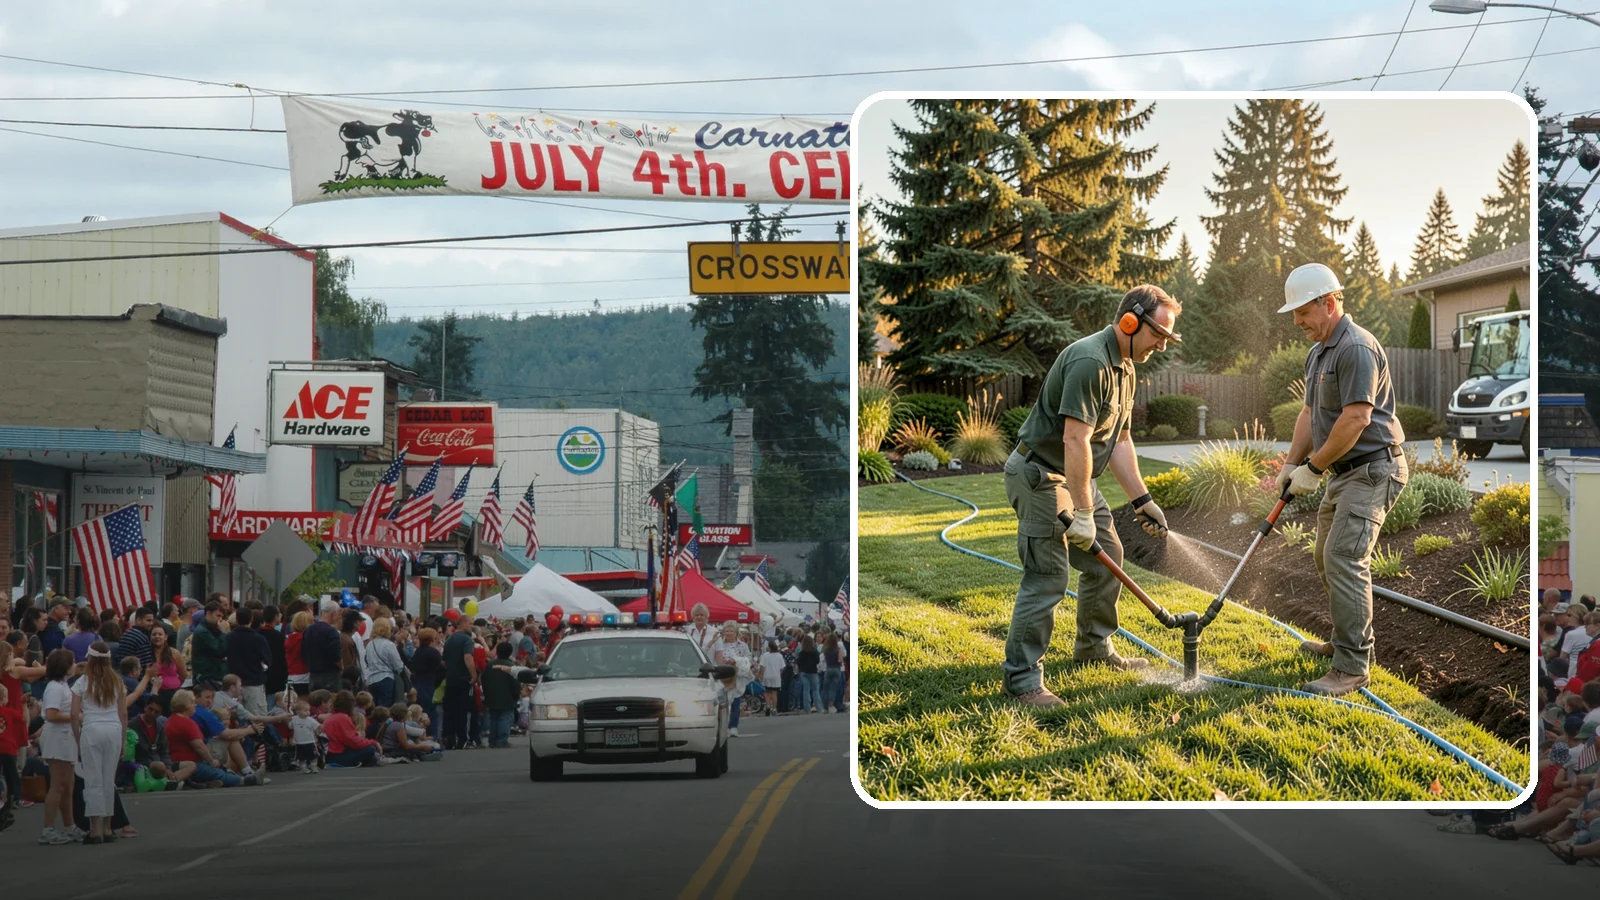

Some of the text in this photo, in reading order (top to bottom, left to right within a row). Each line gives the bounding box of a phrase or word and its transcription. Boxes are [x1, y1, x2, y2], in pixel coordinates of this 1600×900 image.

[695, 121, 850, 150] Carnat
[481, 141, 605, 192] JULY
[632, 150, 747, 198] 4th.
[696, 254, 850, 280] CROSSWA
[283, 380, 373, 420] ACE
[405, 409, 453, 422] CEDAR
[283, 421, 371, 436] Hardware
[95, 485, 124, 495] Vincent
[127, 486, 136, 495] de
[137, 486, 155, 495] Paul
[688, 526, 741, 535] CRNATION
[699, 535, 730, 543] GLASS
